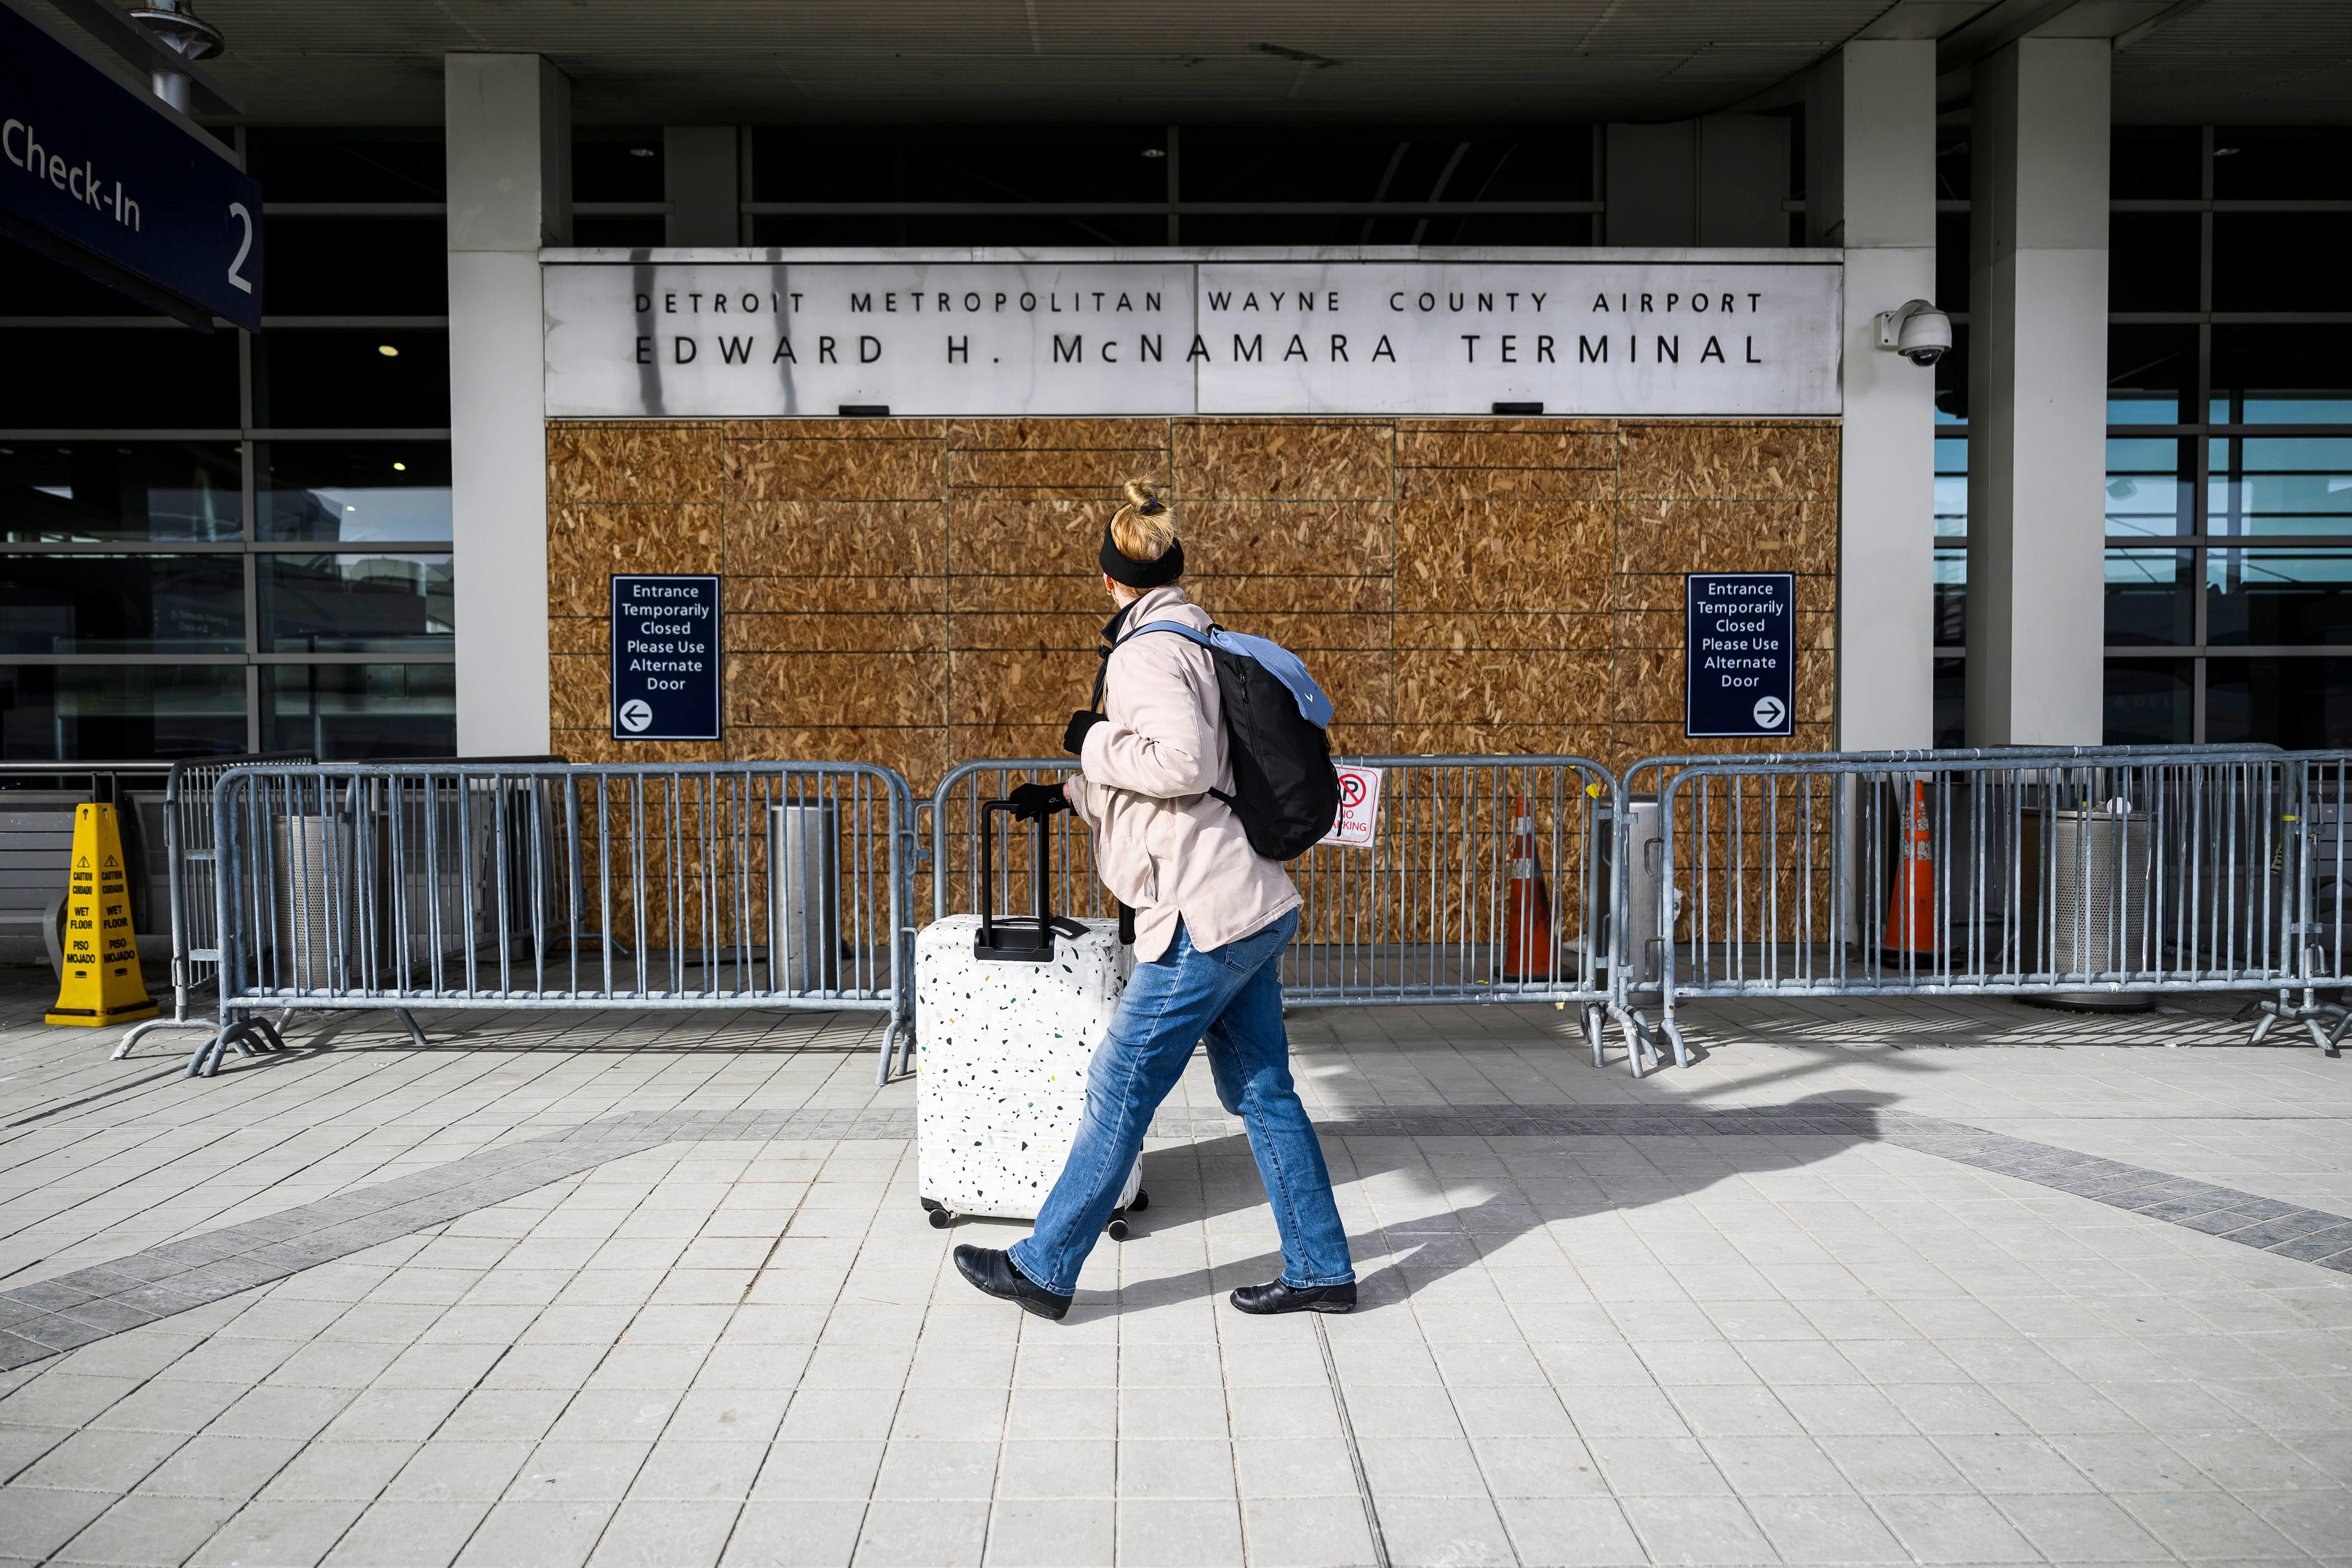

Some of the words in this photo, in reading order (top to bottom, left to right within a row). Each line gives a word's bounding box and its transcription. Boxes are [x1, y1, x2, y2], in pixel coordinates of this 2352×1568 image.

[2, 119, 140, 233] Check-In
[228, 202, 252, 295] 2
[636, 292, 804, 313] DETROIT
[851, 292, 1162, 312] METROPOLITAN
[1208, 291, 1340, 311] WAYNE
[1390, 292, 1547, 312] COUNTY
[1593, 292, 1762, 313] AIRPORT
[636, 336, 881, 364] EDWARD
[948, 336, 999, 363] H.
[1054, 334, 1396, 363] McNAMARA
[1461, 335, 1761, 363] TERMINAL
[634, 585, 698, 597] Entrance
[1708, 583, 1773, 595] Entrance
[622, 603, 709, 619] Temporarily
[1697, 600, 1783, 616] Temporarily
[641, 621, 691, 634] Closed
[1716, 619, 1765, 631] Closed
[627, 640, 673, 653] Please
[678, 641, 705, 653] Use
[1703, 637, 1748, 650] Please
[1753, 638, 1779, 650] Use
[630, 659, 702, 671] Alternate
[1704, 656, 1776, 668] Alternate
[648, 678, 686, 689] Door
[1722, 675, 1759, 687] Door
[1332, 820, 1367, 832] AKING
[73, 872, 92, 881] CAUTION
[101, 870, 122, 880] CAUTION
[73, 885, 92, 895] CUIDADO
[102, 884, 124, 894] CUIDADO
[74, 907, 89, 916] WET
[106, 905, 122, 915] WET
[70, 920, 92, 929] FLOOR
[103, 917, 128, 929] FLOOR
[73, 941, 89, 950] PISO
[109, 938, 126, 950] PISO
[67, 953, 96, 964] MOJADO
[103, 950, 135, 964] MOJADO
